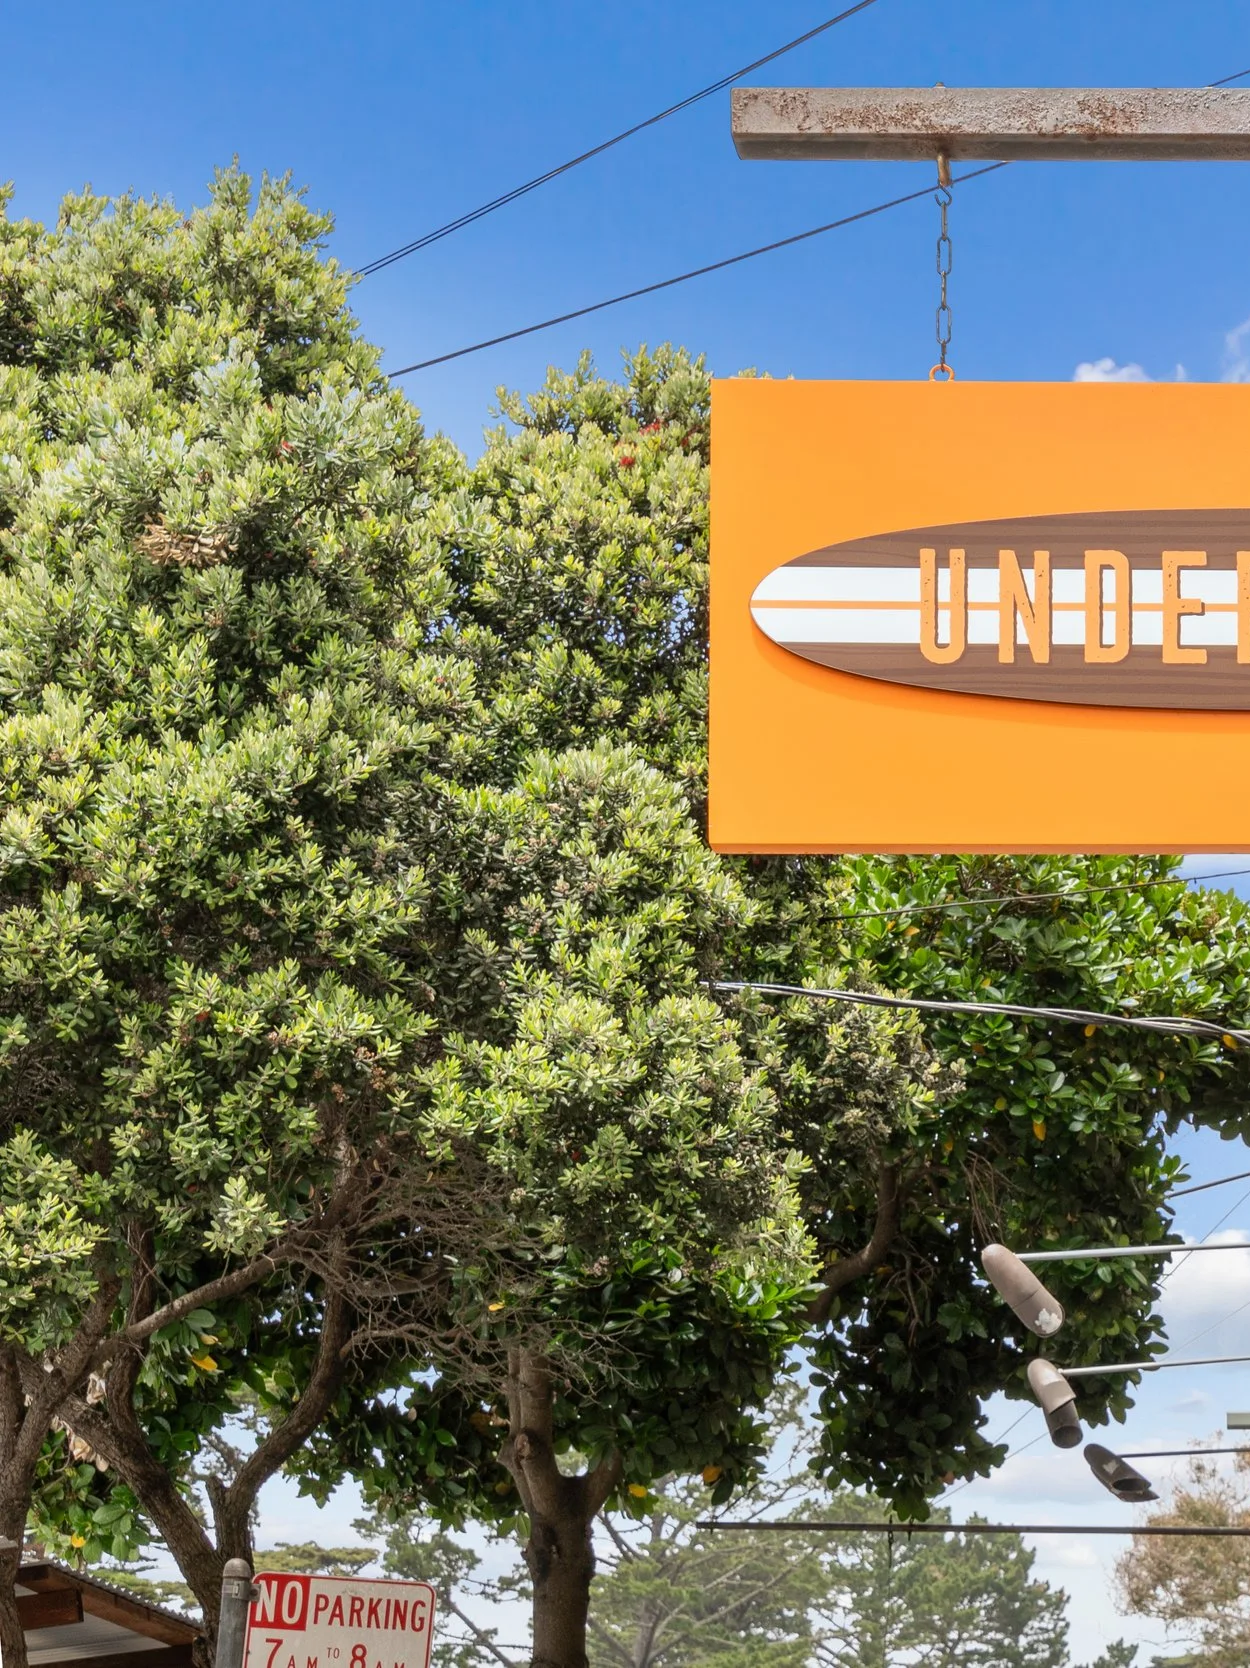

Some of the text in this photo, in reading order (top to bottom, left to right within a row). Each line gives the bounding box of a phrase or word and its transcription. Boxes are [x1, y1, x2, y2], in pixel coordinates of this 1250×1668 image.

[255, 1580, 426, 1632] NO PARKING
[327, 1647, 340, 1659] TO
